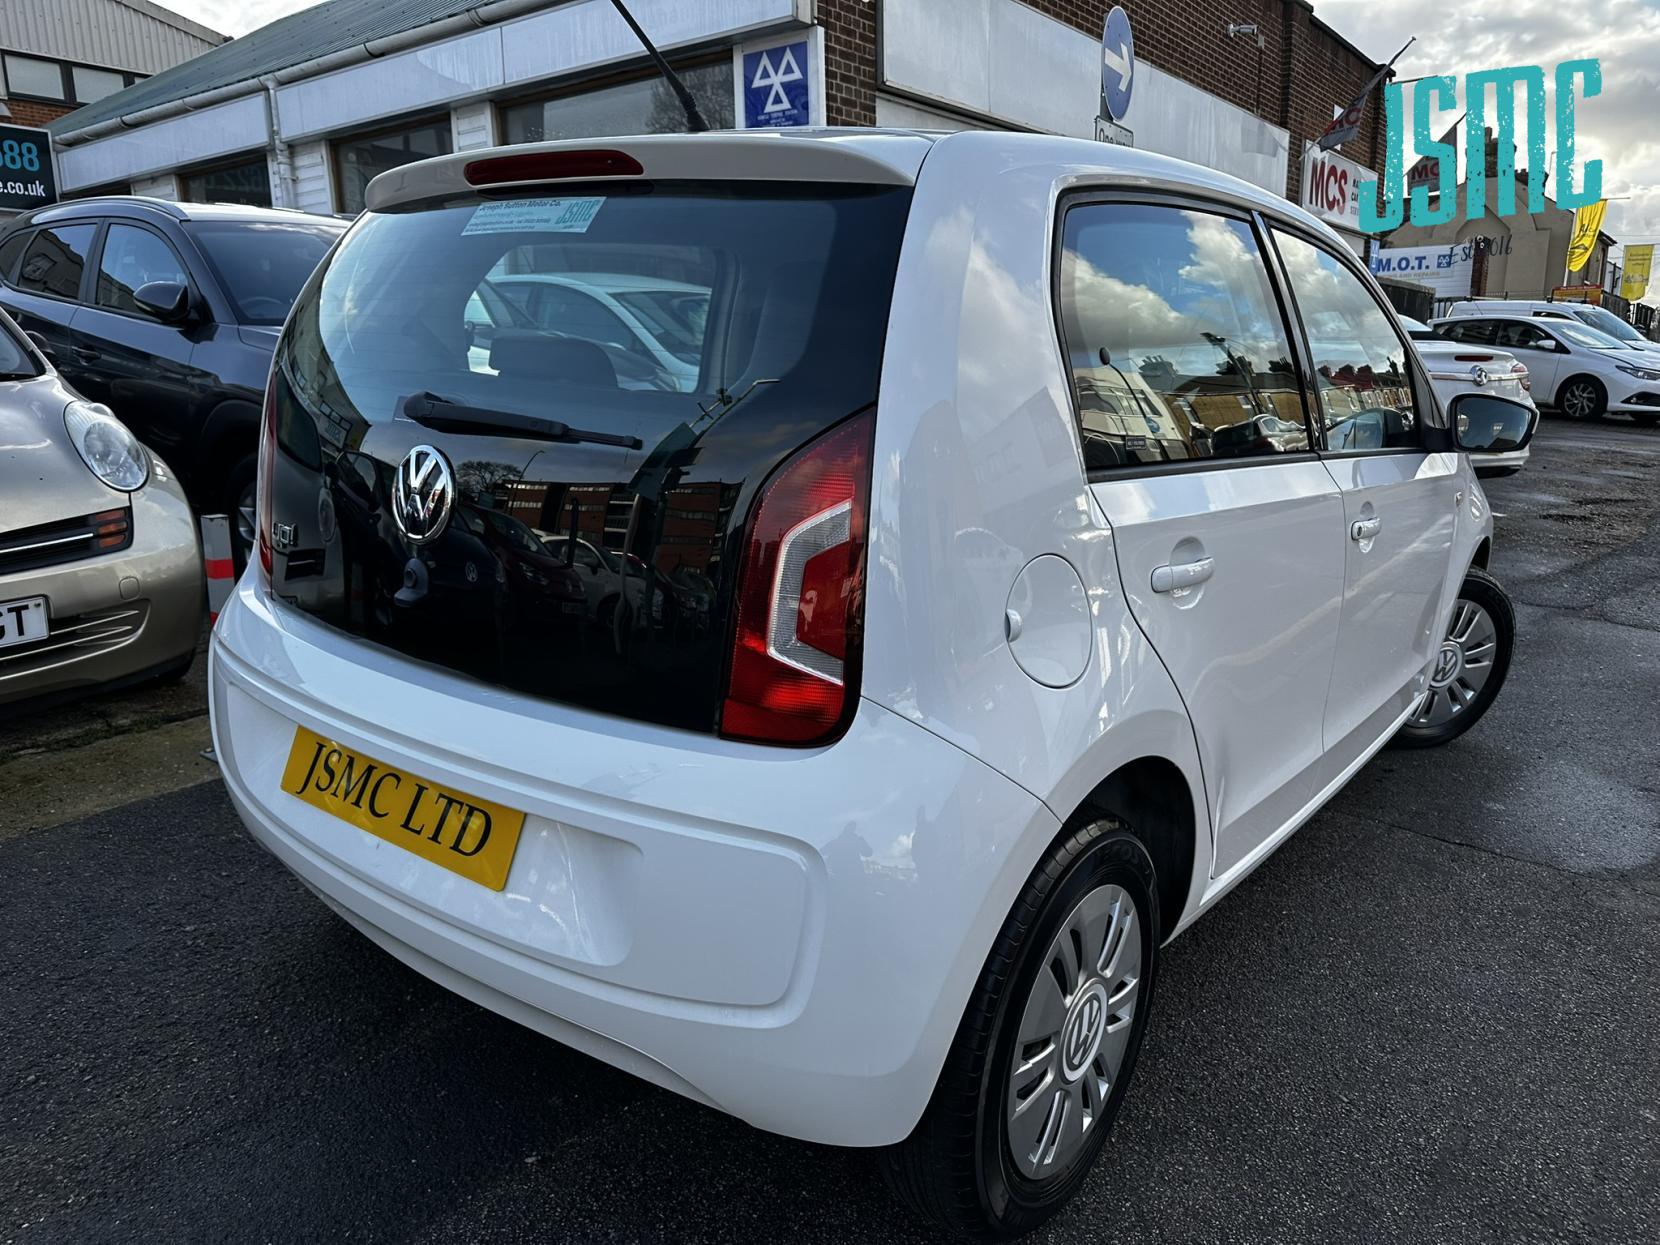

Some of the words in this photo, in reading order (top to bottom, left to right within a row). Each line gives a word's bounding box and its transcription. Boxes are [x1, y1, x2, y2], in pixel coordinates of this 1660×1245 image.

[0, 139, 40, 172] 88
[1309, 159, 1348, 216] MCS
[1378, 256, 1430, 272] M.O.T.
[295, 741, 402, 819] JSMC
[400, 782, 493, 857] LTD
